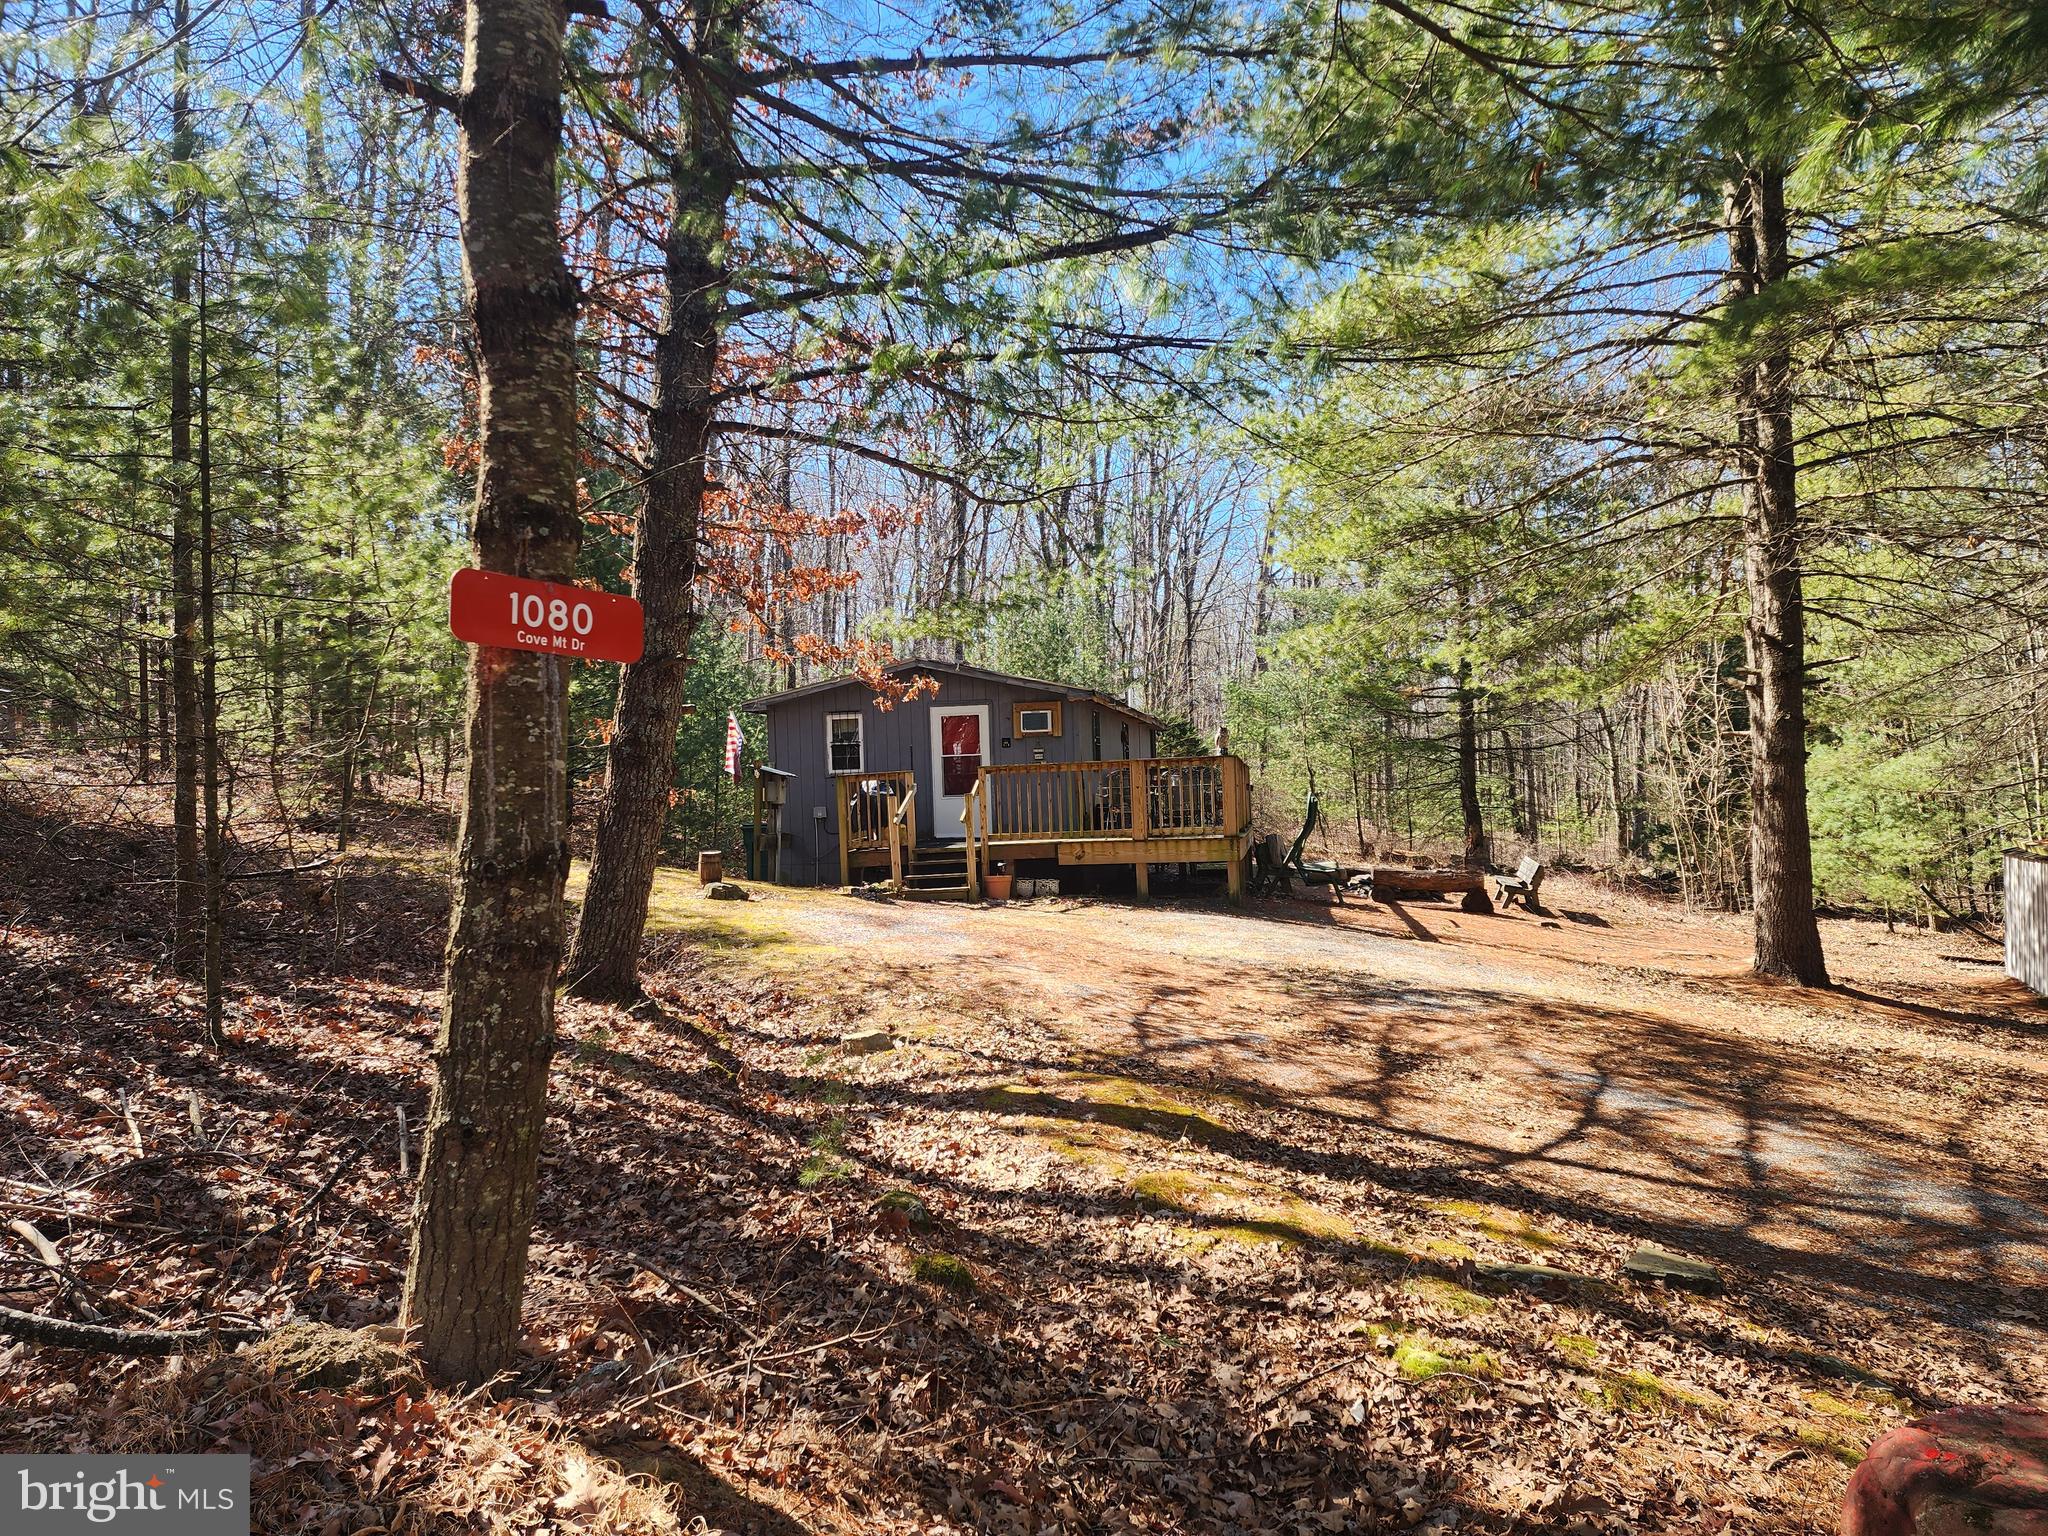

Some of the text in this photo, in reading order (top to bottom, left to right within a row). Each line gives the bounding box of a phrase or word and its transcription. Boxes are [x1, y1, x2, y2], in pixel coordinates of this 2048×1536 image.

[509, 592, 593, 635] 1080
[517, 631, 586, 651] Cove Mt Dr
